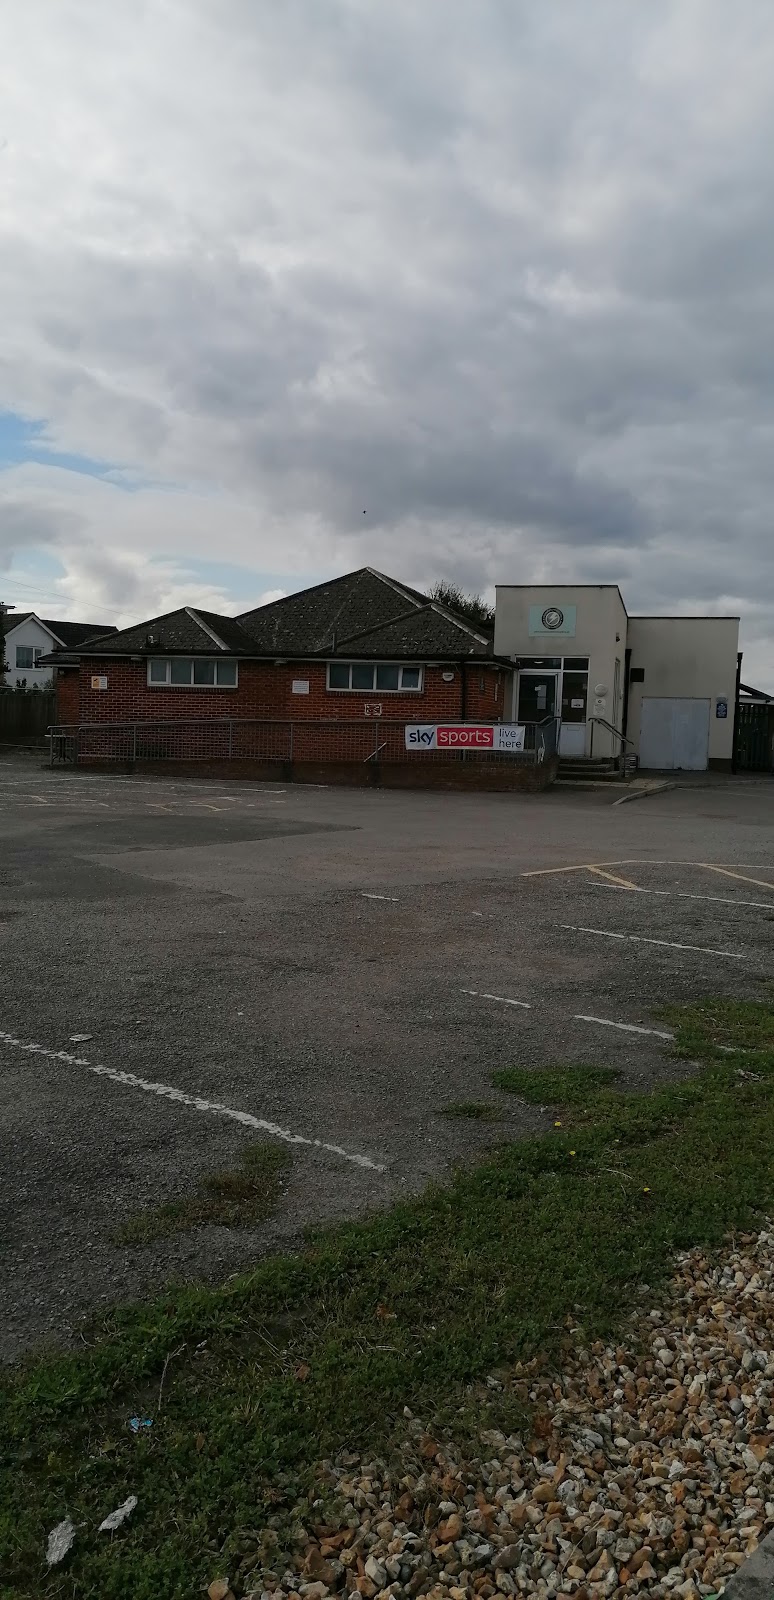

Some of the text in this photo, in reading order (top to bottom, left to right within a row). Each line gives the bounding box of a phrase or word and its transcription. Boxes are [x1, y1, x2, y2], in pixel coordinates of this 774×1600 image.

[409, 729, 491, 745] sky sports
[499, 728, 516, 738] live
[498, 739, 522, 749] here
